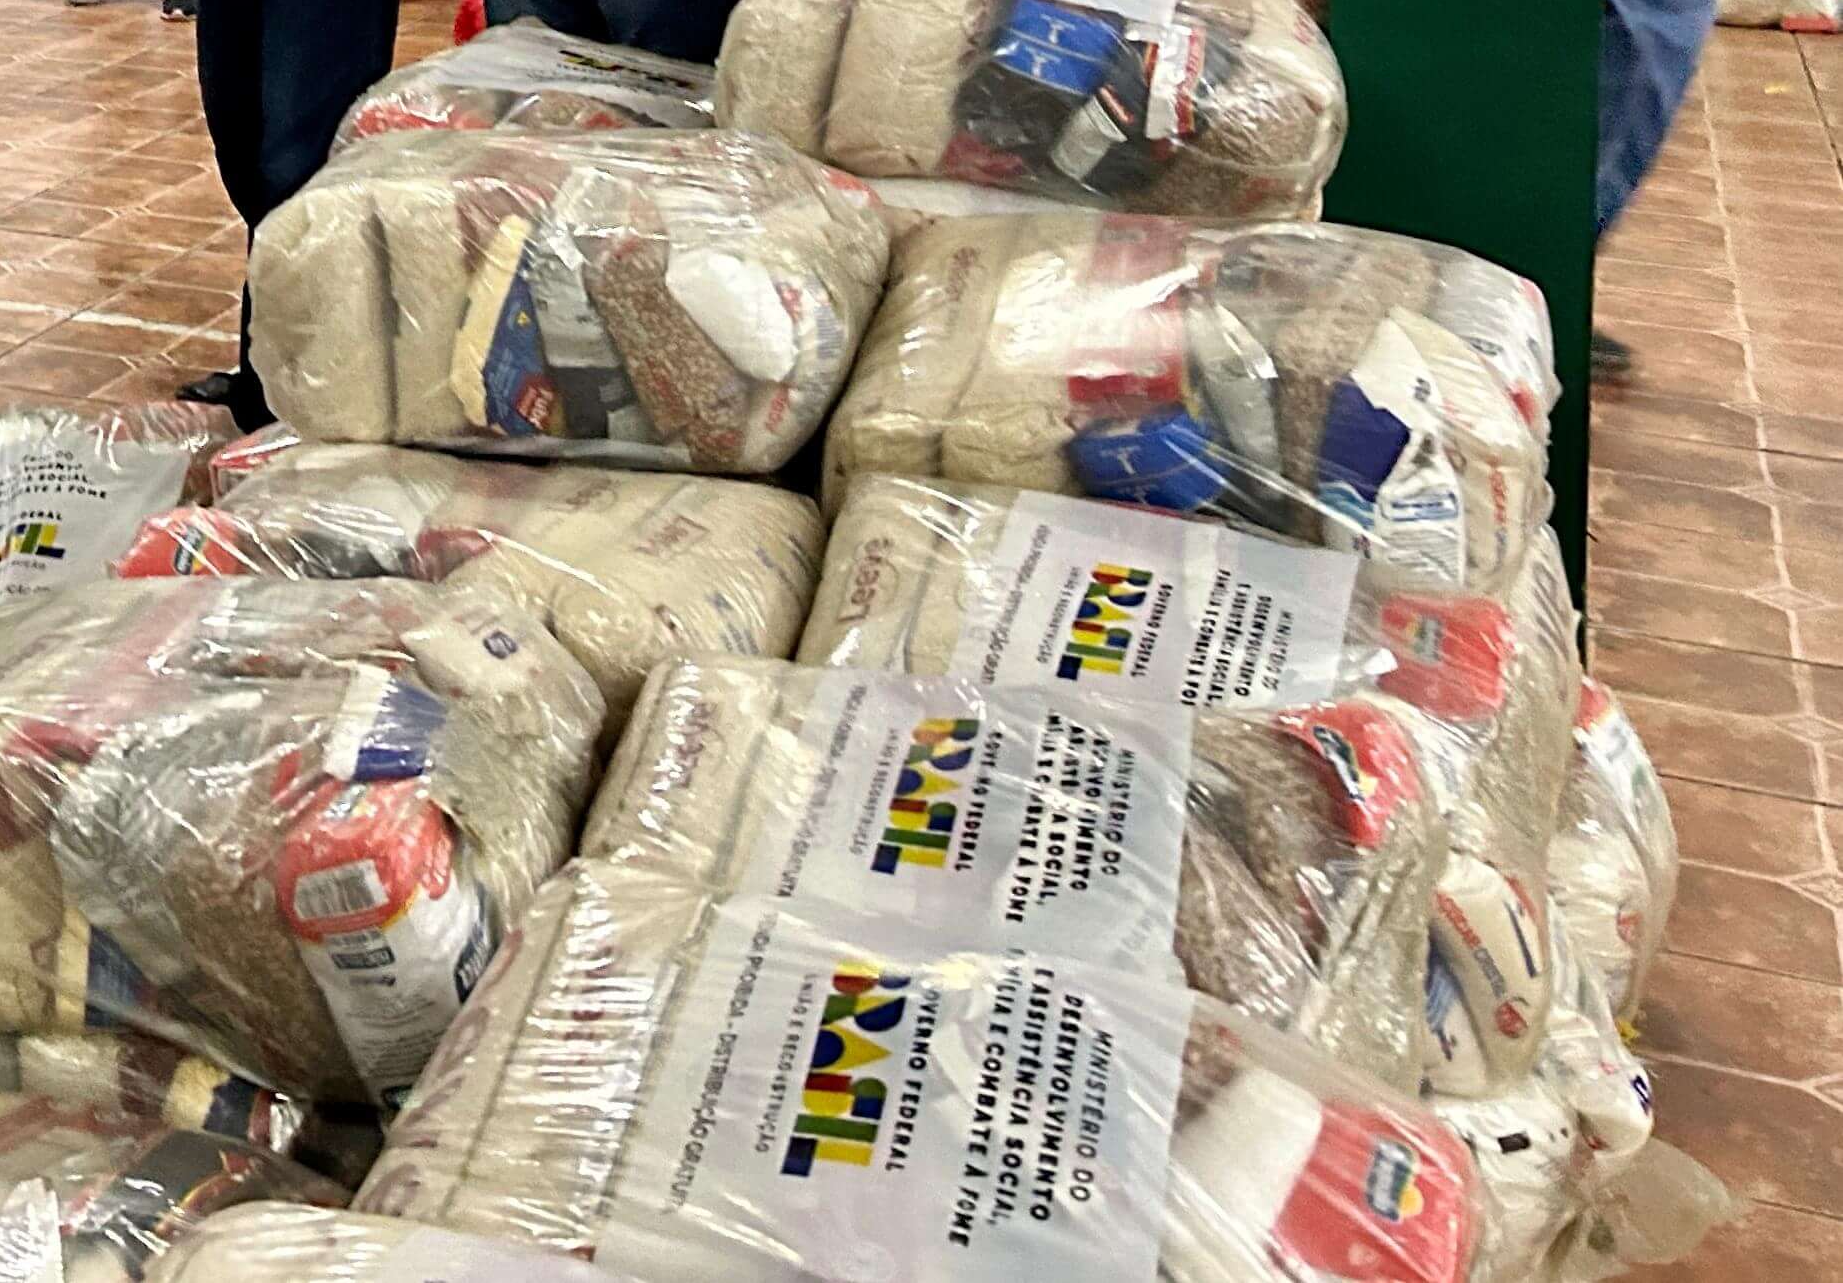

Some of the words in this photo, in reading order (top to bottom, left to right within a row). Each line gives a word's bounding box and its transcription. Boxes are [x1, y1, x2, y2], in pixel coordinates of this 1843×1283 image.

[954, 801, 986, 870] FEDERAL
[1005, 874, 1031, 923] FOME
[988, 1022, 1009, 1036] E
[1008, 983, 1052, 1127] ASSISTÊNCIA
[885, 1079, 924, 1172] FEDERAL
[967, 1042, 1006, 1157] COMBATE
[1029, 993, 1085, 1221] DESENVOLVIMENTO
[1075, 1029, 1114, 1159] MINISTÉRIO
[948, 1185, 981, 1247] FOME
[986, 1136, 1025, 1226] SOCIAL,
[1070, 1166, 1094, 1202] DO
